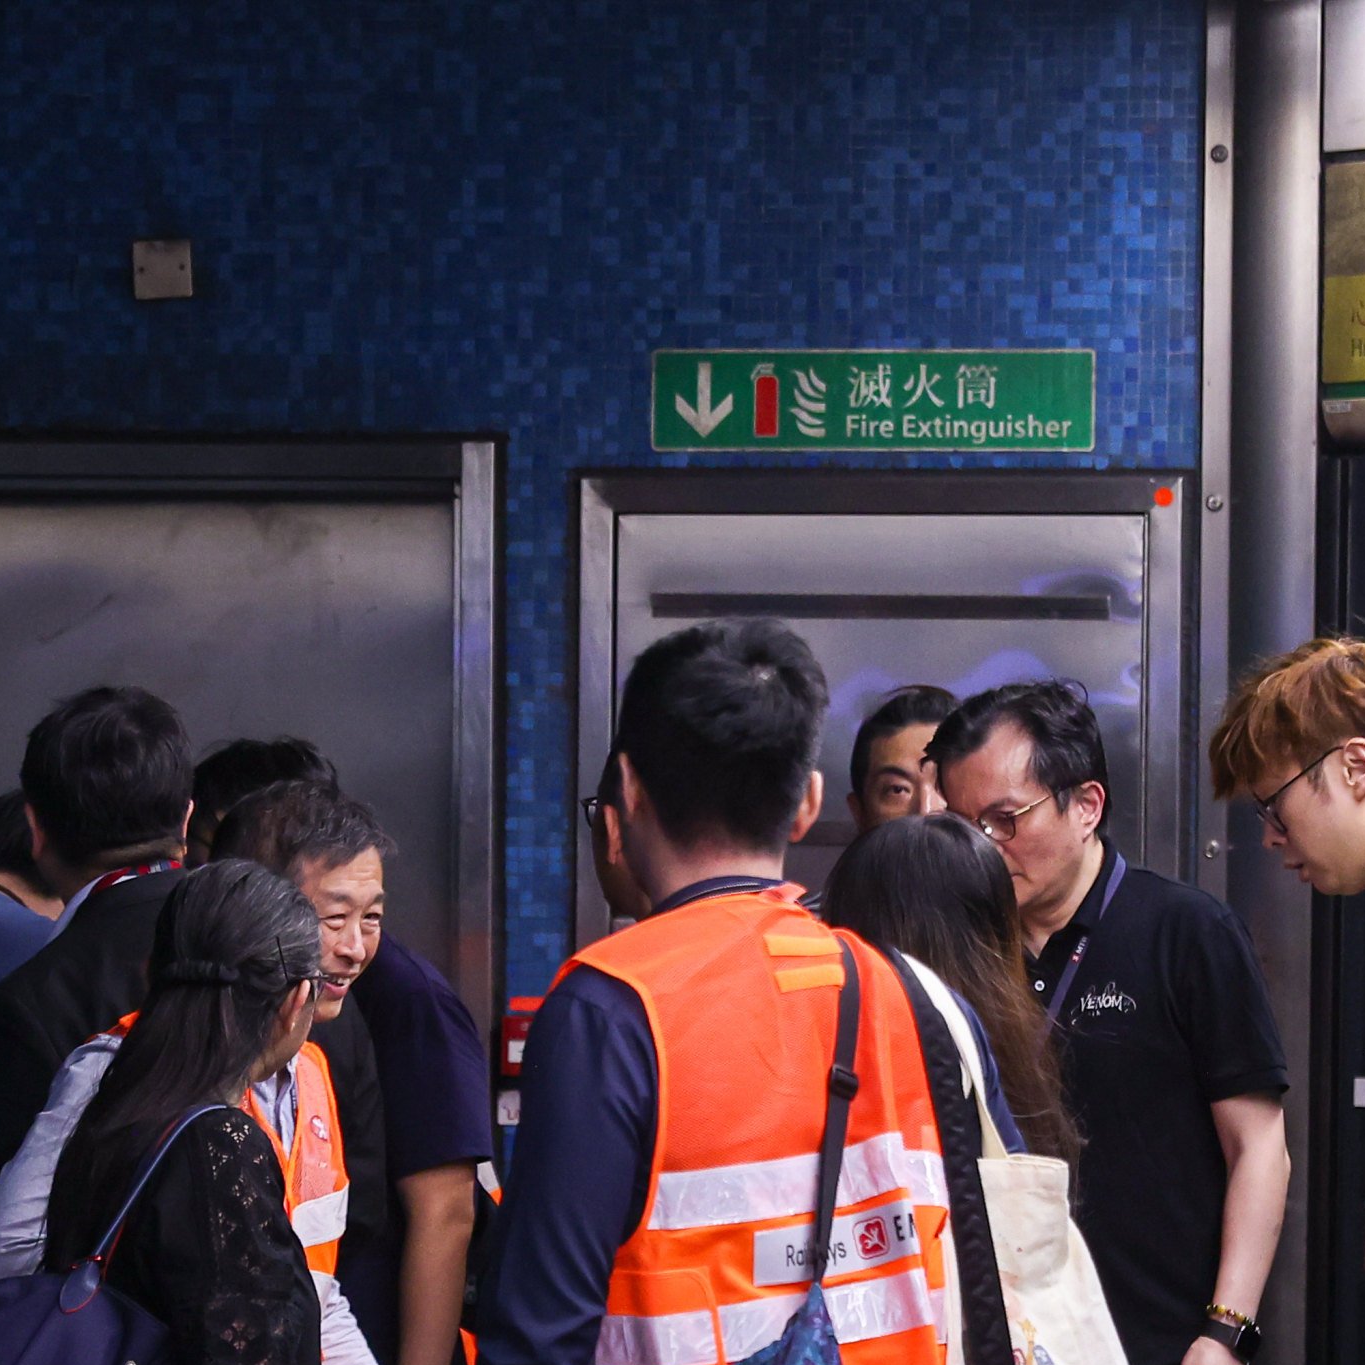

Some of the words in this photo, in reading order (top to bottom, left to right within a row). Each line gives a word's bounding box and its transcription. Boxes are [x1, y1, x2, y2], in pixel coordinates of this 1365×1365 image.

[848, 363, 998, 409] 滅火筒
[846, 414, 895, 438] Fire
[902, 413, 1073, 443] Extinguisher
[1080, 992, 1124, 1013] VENOM
